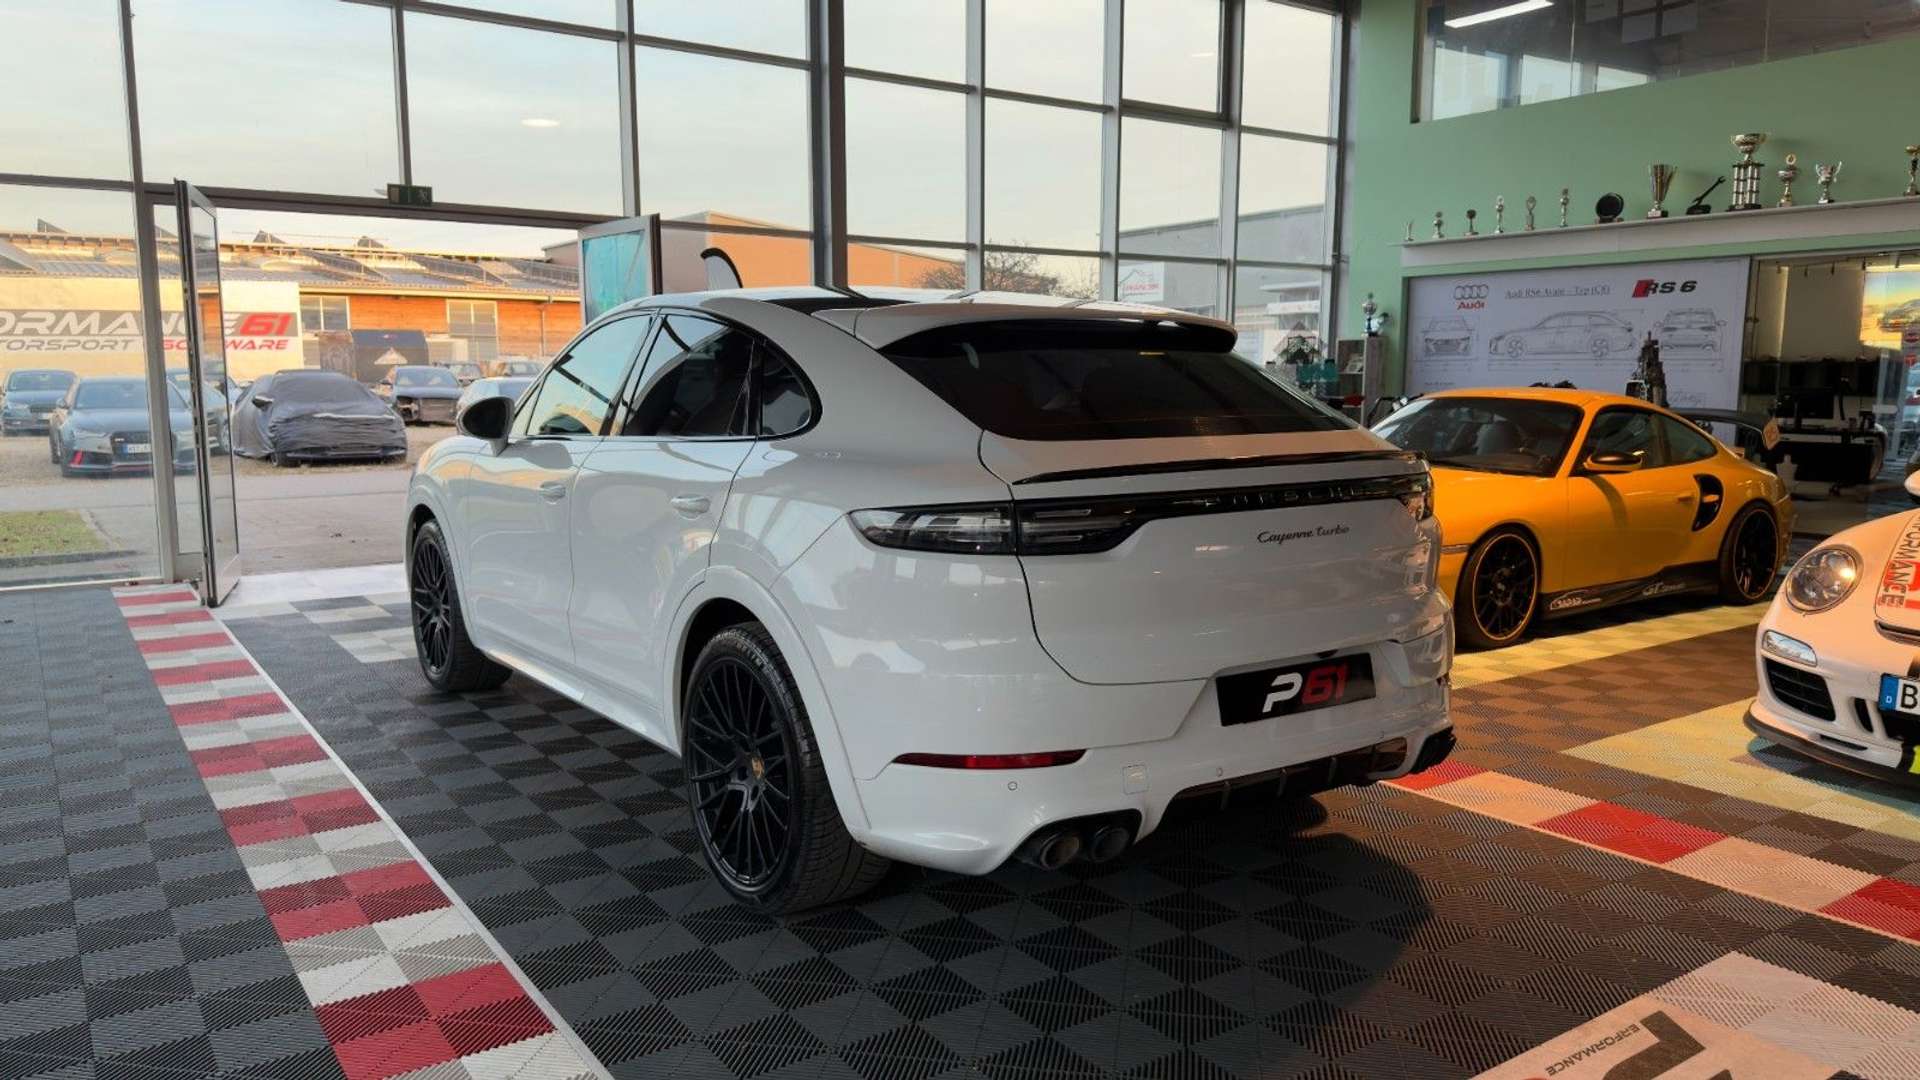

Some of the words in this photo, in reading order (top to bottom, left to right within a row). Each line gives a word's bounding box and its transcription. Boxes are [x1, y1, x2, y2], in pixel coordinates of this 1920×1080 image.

[1456, 300, 1487, 311] Audi
[0, 339, 133, 351] ORSPORT
[1256, 530, 1313, 545] Cayenne
[1316, 524, 1350, 537] turbo
[1262, 663, 1347, 713] P61
